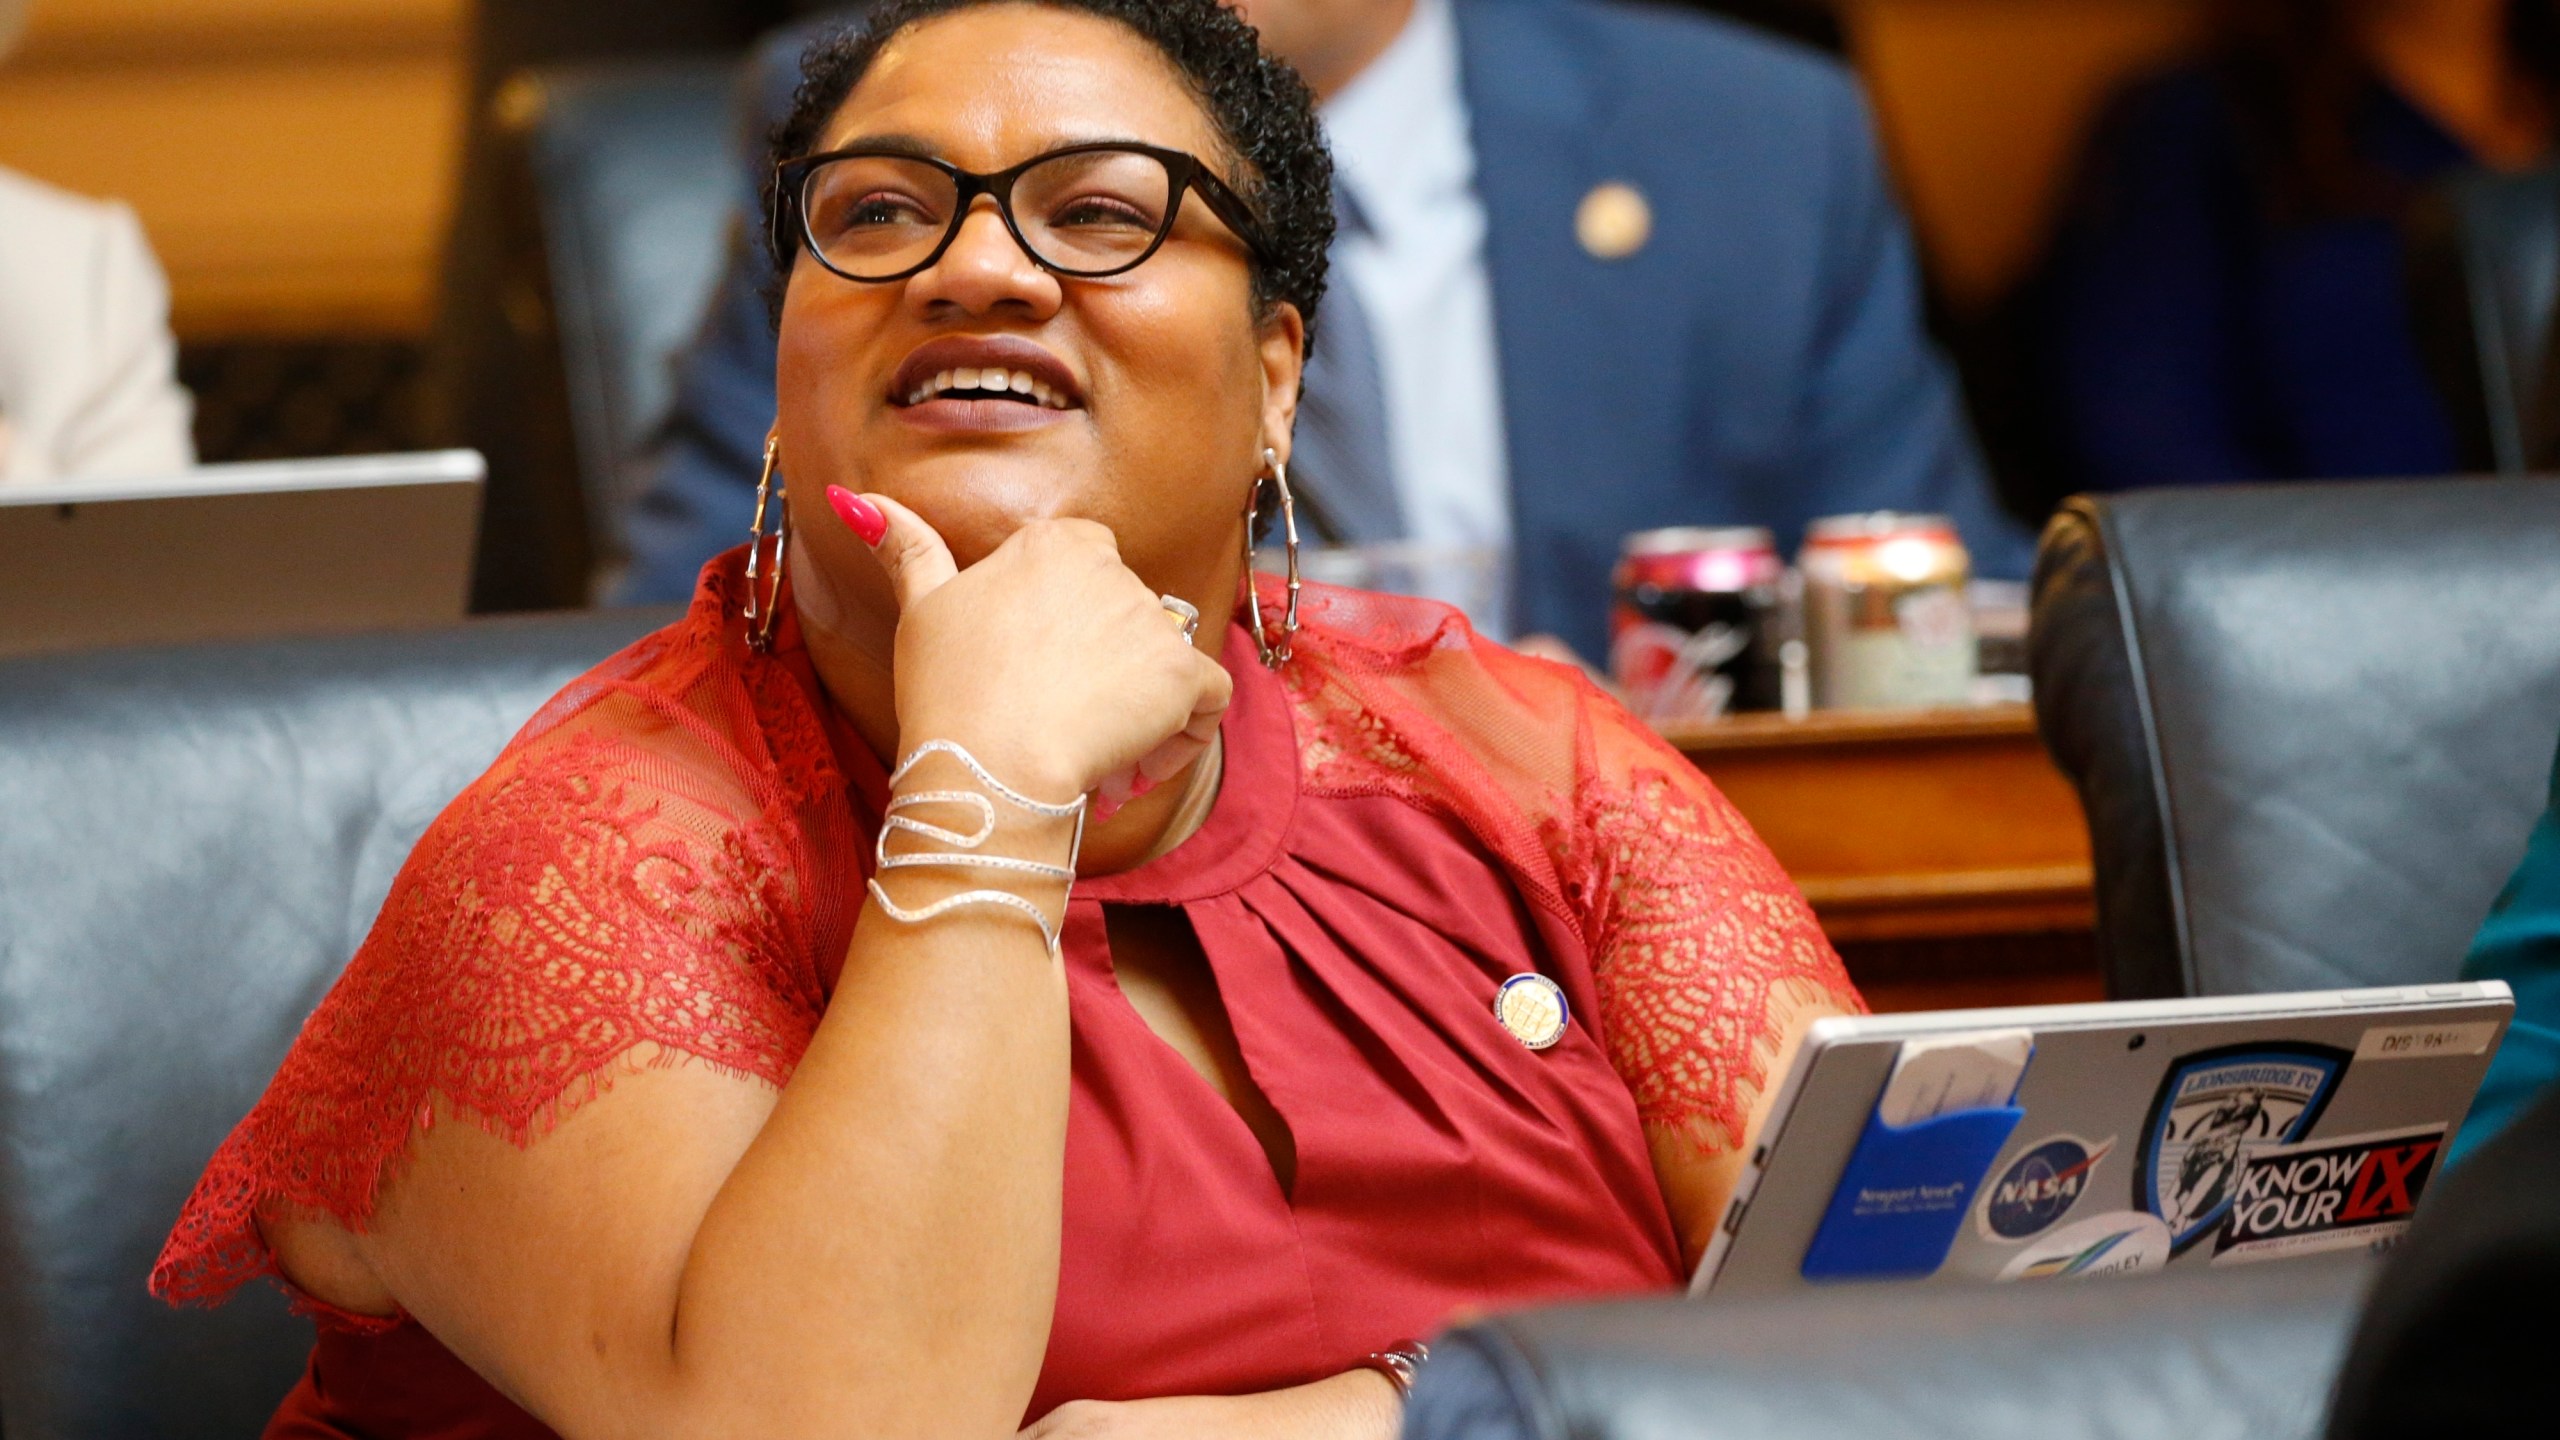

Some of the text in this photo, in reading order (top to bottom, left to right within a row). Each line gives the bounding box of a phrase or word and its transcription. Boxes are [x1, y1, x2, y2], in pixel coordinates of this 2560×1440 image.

[2184, 1068, 2318, 1093] LIONSBRIDGE FC
[1998, 1172, 2078, 1204] NASA
[2235, 1150, 2371, 1203] KNOW
[2336, 1140, 2443, 1222] IX
[2230, 1188, 2342, 1238] YOUR
[2352, 1226, 2372, 1237] FOR
